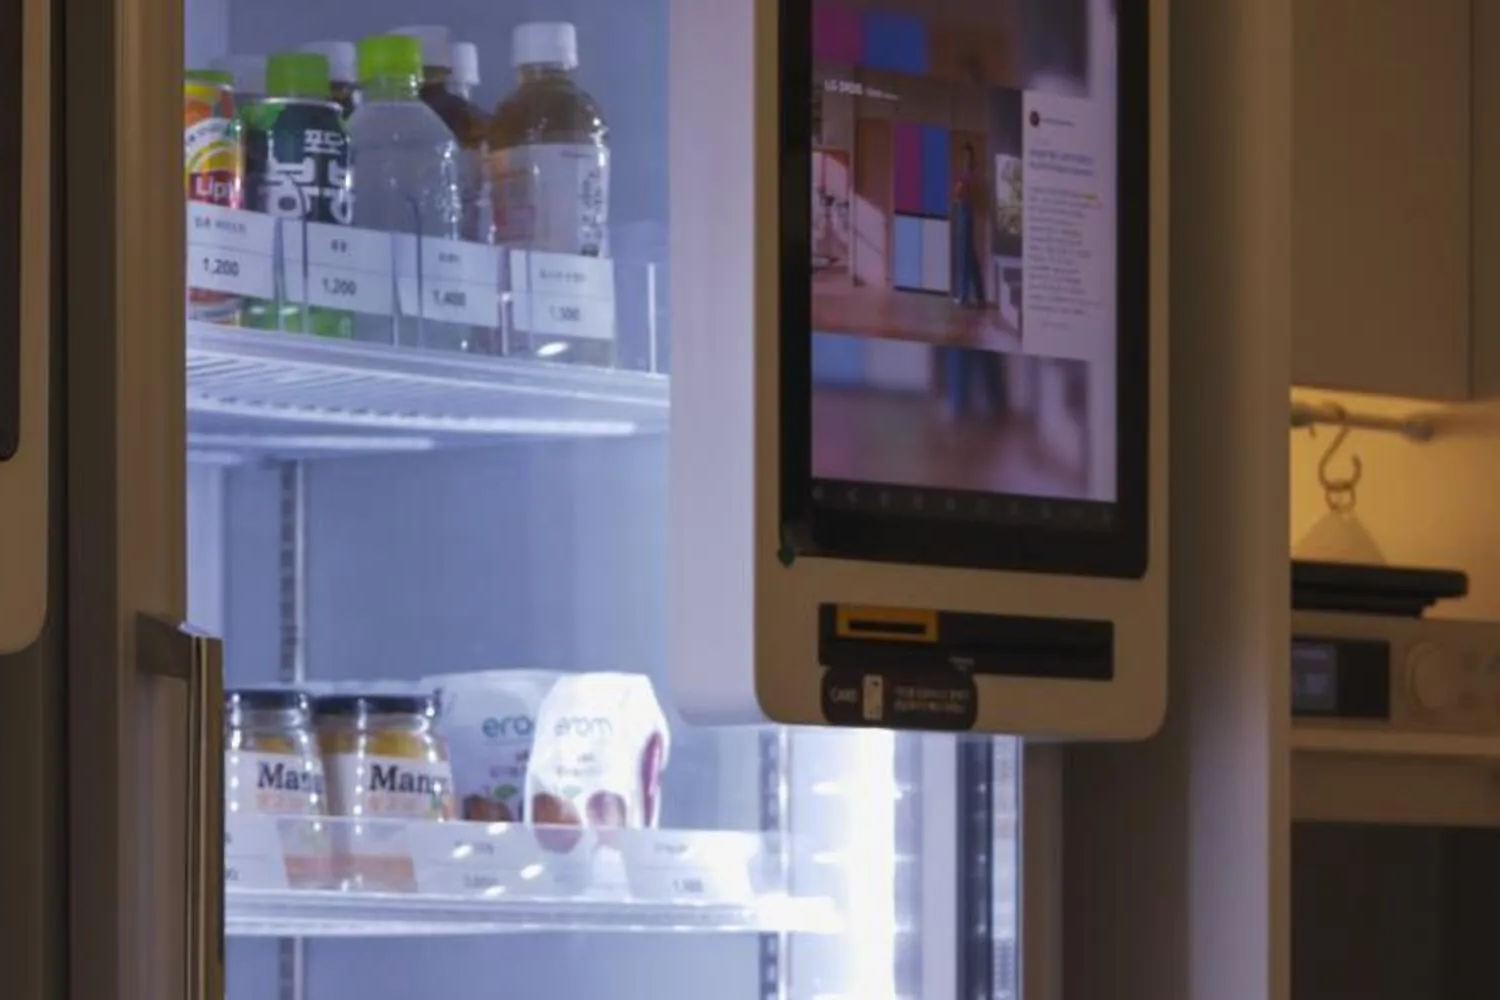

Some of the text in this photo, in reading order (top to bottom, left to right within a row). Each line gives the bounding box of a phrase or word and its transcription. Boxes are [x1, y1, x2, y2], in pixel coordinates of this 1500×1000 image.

[202, 257, 240, 276] 1,200
[482, 714, 534, 737] ero
[554, 715, 613, 737] erom
